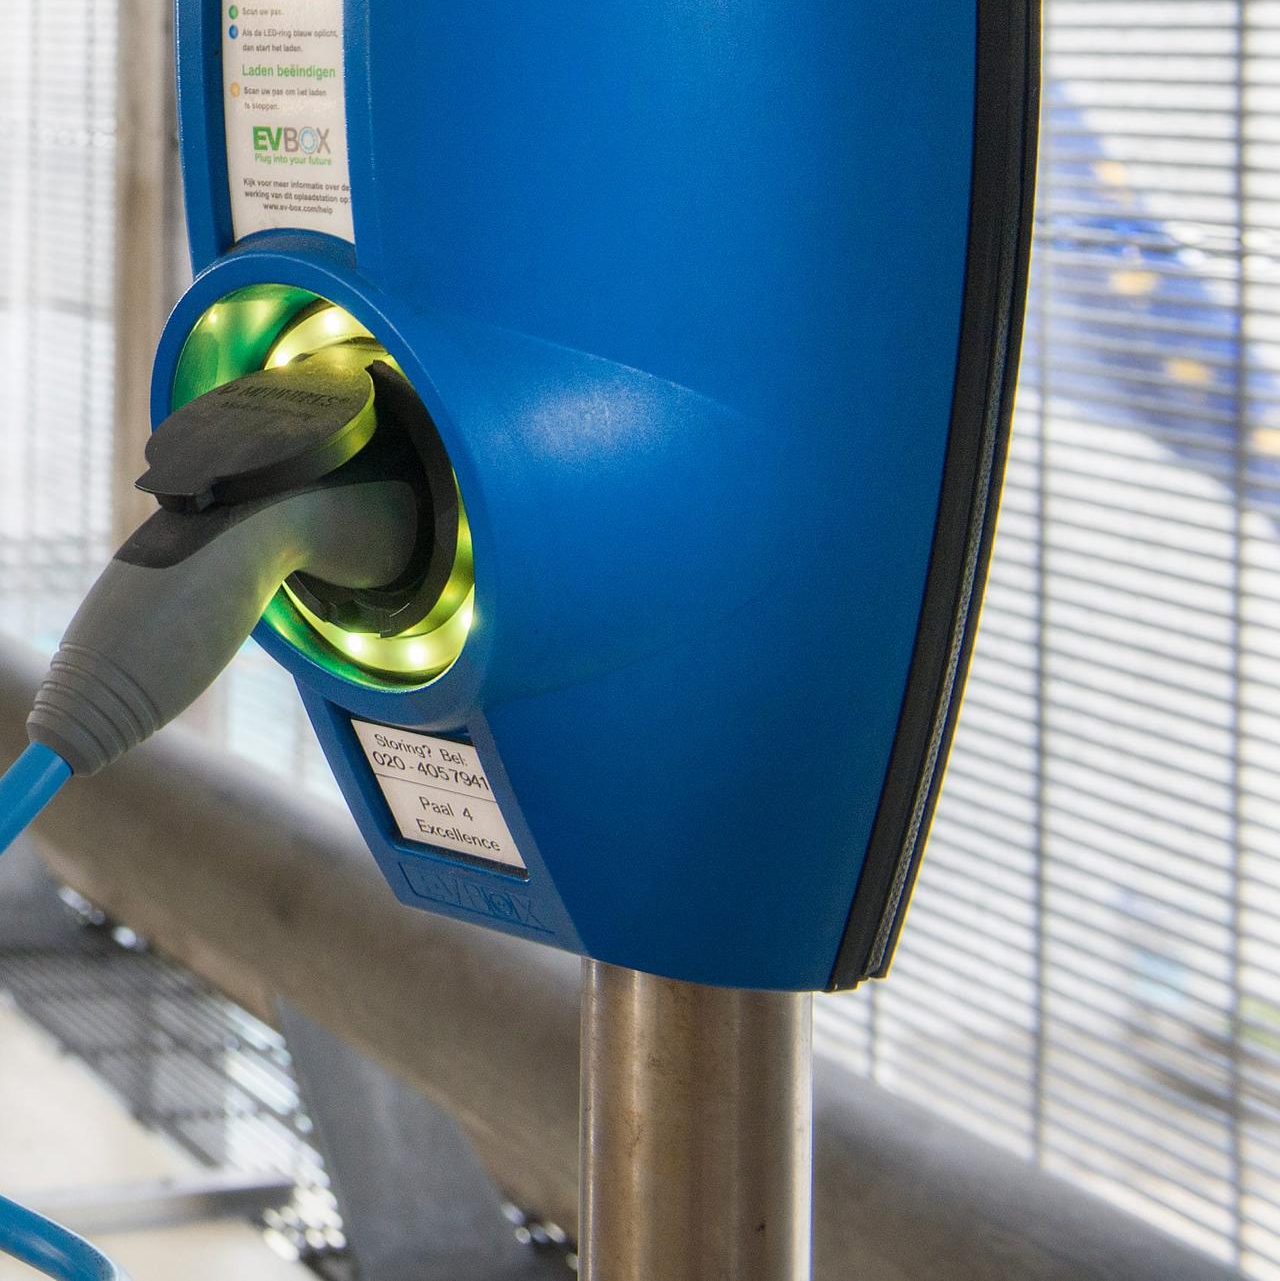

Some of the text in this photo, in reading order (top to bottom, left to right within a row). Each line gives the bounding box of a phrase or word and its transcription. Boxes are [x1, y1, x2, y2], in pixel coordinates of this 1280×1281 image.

[242, 64, 336, 81] Laden beëindigen
[244, 87, 260, 95] Scan
[252, 126, 331, 154] EVBOX
[255, 152, 332, 166] Plug into your future
[273, 180, 289, 188] meer
[374, 733, 467, 768] Storing? Bel:
[418, 796, 474, 822] Paal 4
[416, 817, 501, 852] Excellence
